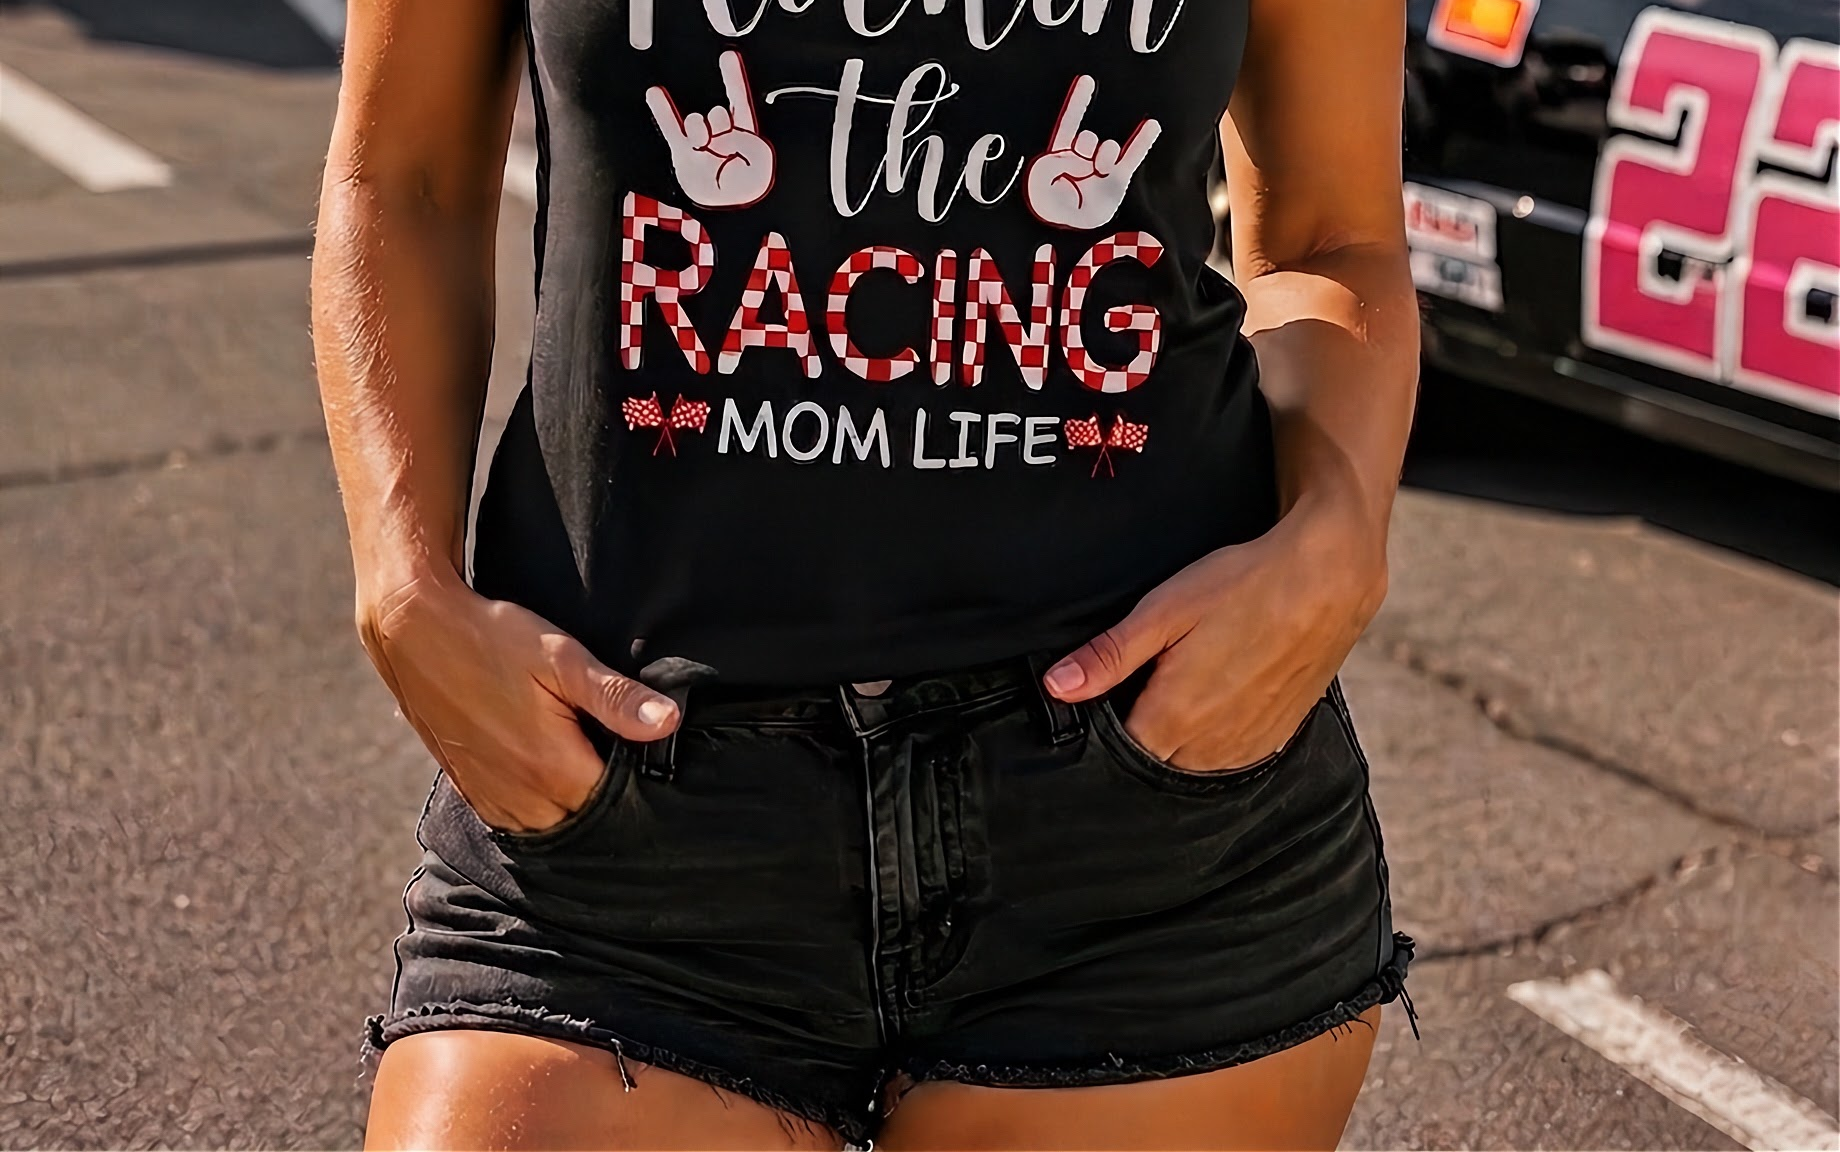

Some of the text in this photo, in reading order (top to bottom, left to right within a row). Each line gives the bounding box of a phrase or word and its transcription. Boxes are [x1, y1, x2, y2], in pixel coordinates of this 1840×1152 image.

[765, 58, 1025, 222] the
[620, 190, 1164, 393] RACING
[717, 398, 1060, 469] MOM LIFE
